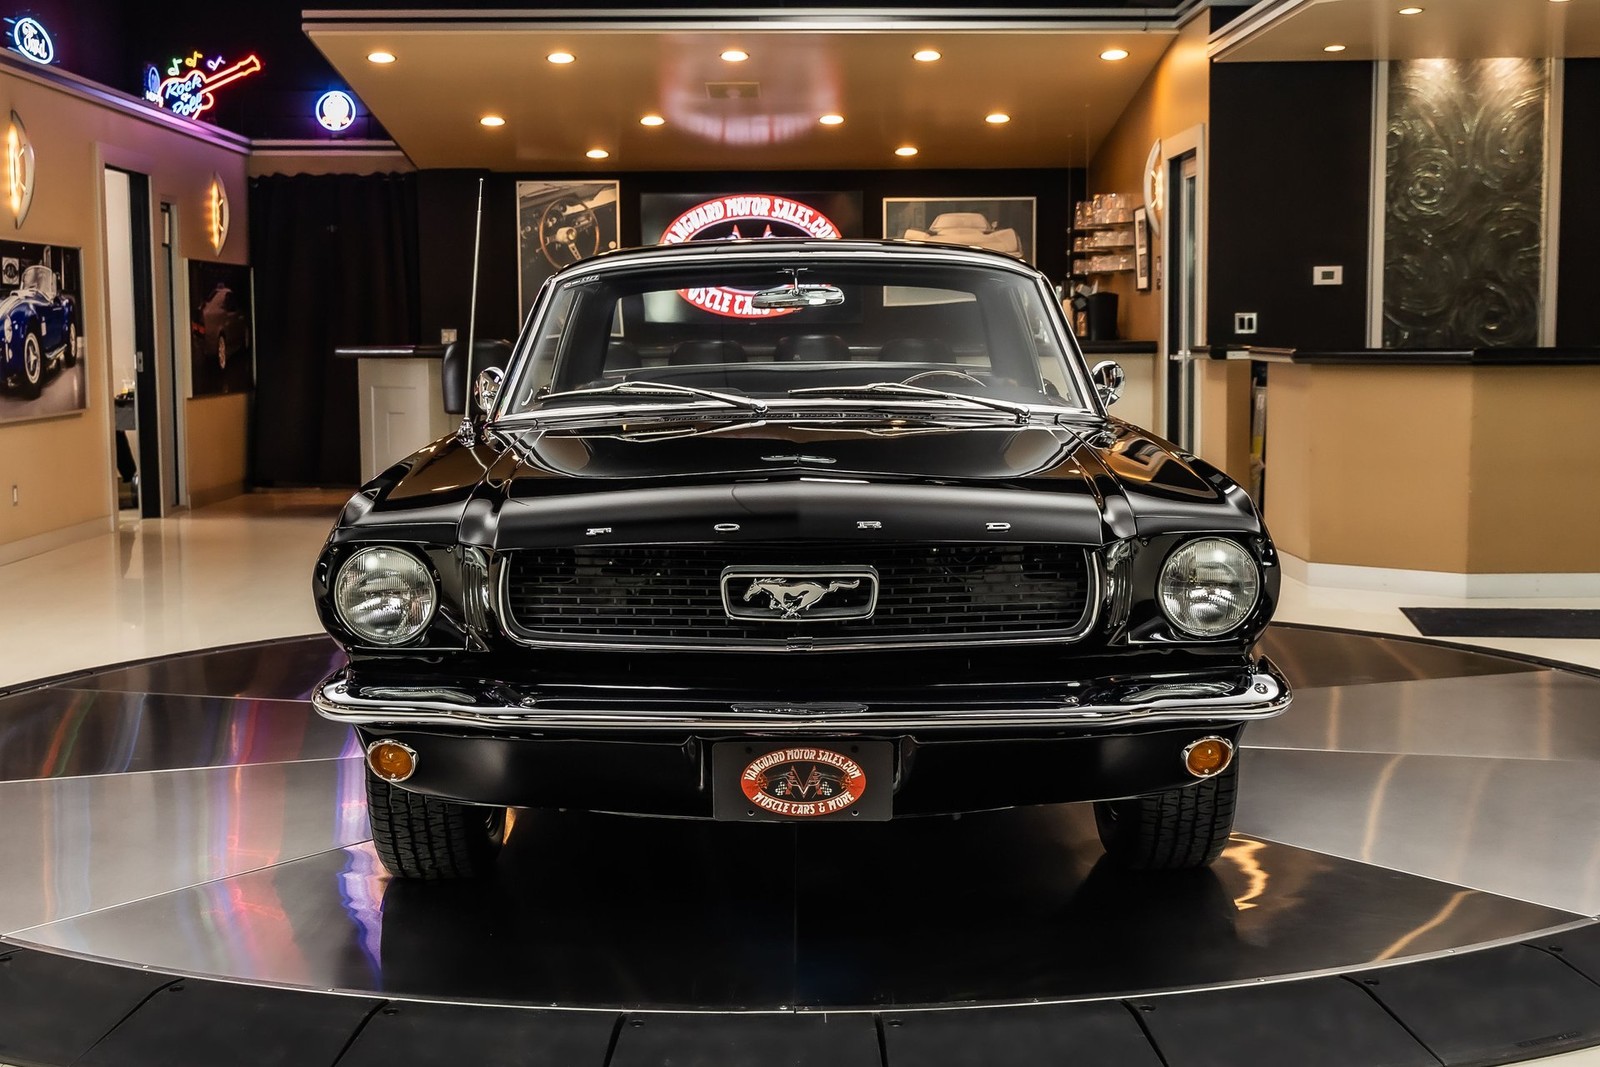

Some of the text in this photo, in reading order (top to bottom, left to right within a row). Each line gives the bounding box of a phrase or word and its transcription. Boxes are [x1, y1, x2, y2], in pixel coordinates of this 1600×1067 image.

[22, 22, 48, 59] Ford
[165, 73, 203, 100] Rock
[664, 201, 725, 245] ANGUARD
[725, 197, 771, 217] MOTOR
[680, 287, 733, 313] USCLE
[744, 749, 861, 781] VANGUARD MOTOR SALES.COM
[751, 791, 855, 815] MUSCLE CARS & MORE
